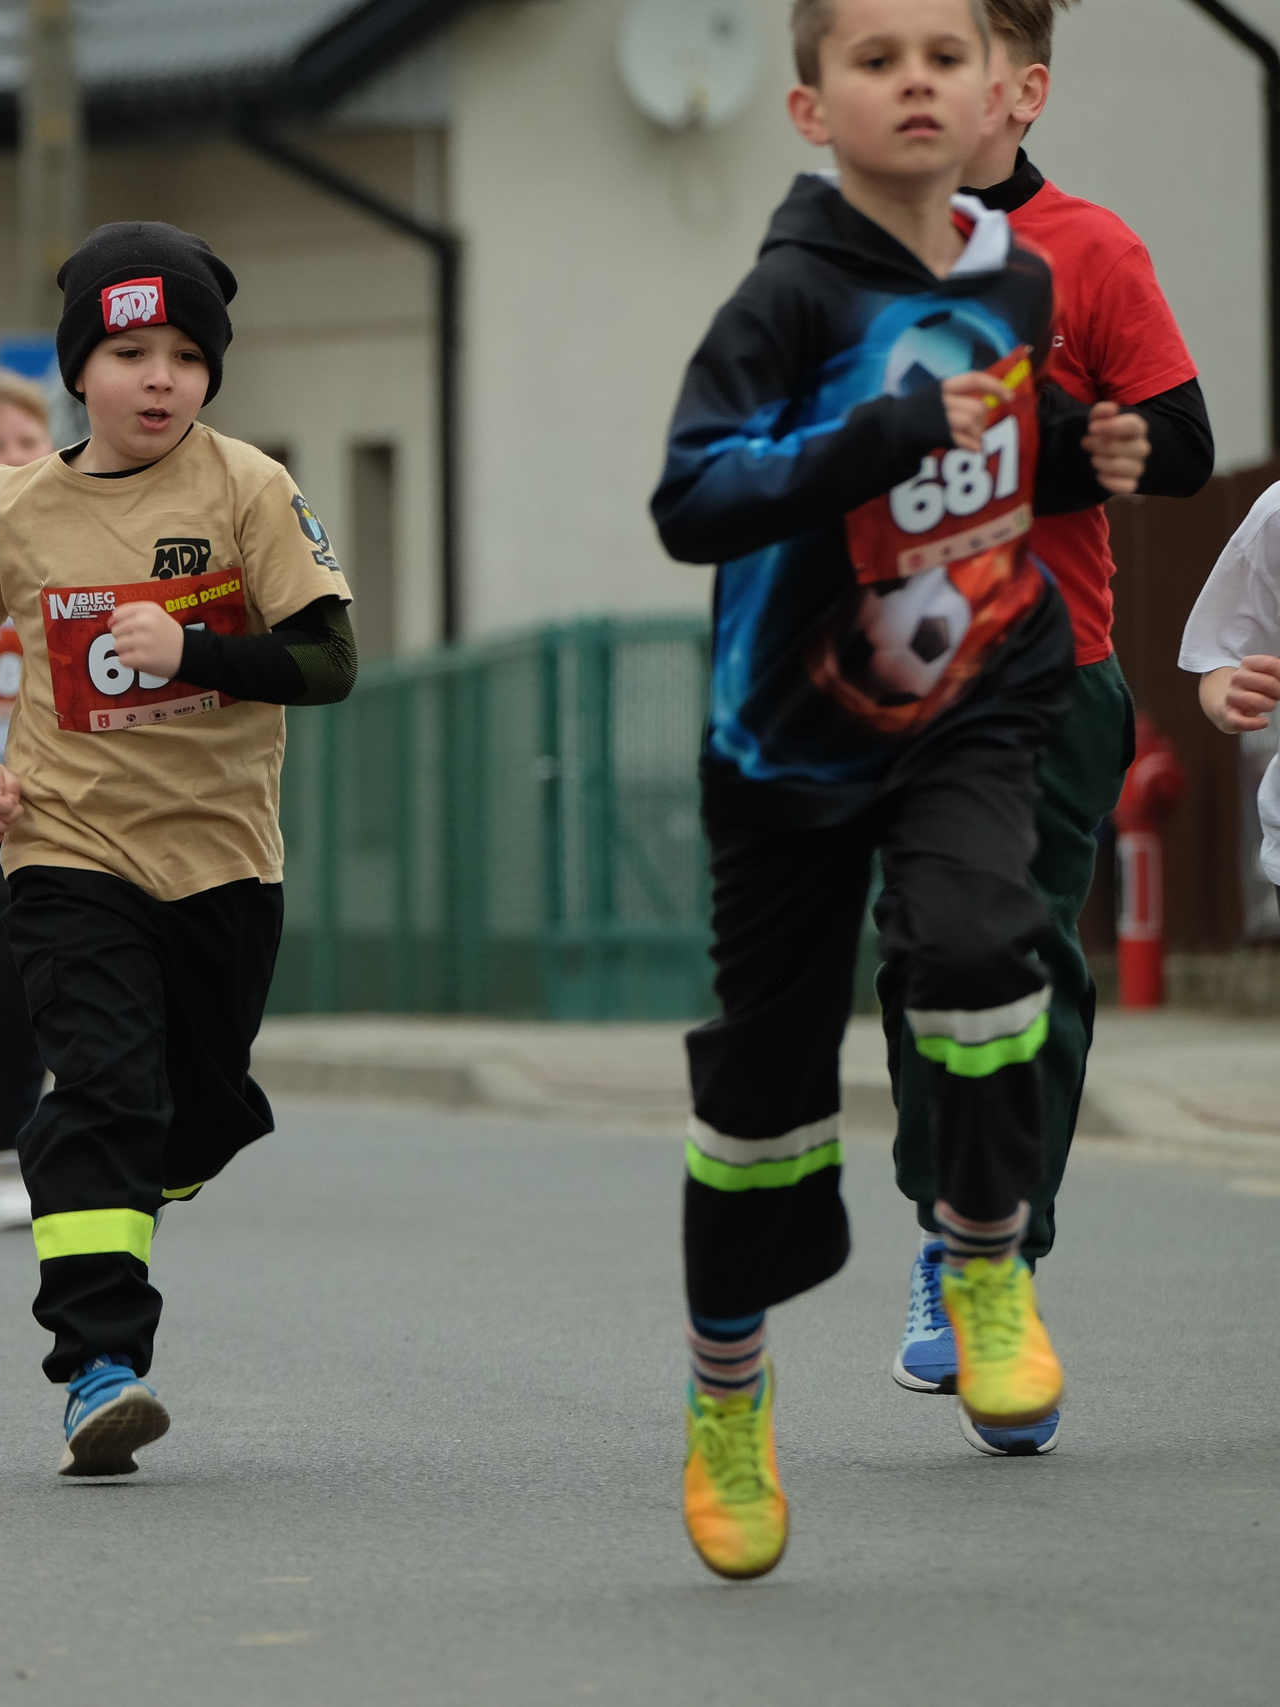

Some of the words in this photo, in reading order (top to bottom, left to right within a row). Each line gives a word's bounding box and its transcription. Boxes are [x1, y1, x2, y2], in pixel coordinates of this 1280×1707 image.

[889, 414, 1018, 534] 687
[48, 593, 77, 620] IV
[76, 591, 116, 606] BIEG
[73, 603, 117, 613] STRAŻAKA
[165, 593, 199, 613] BIEG
[199, 579, 241, 604] DZIECI
